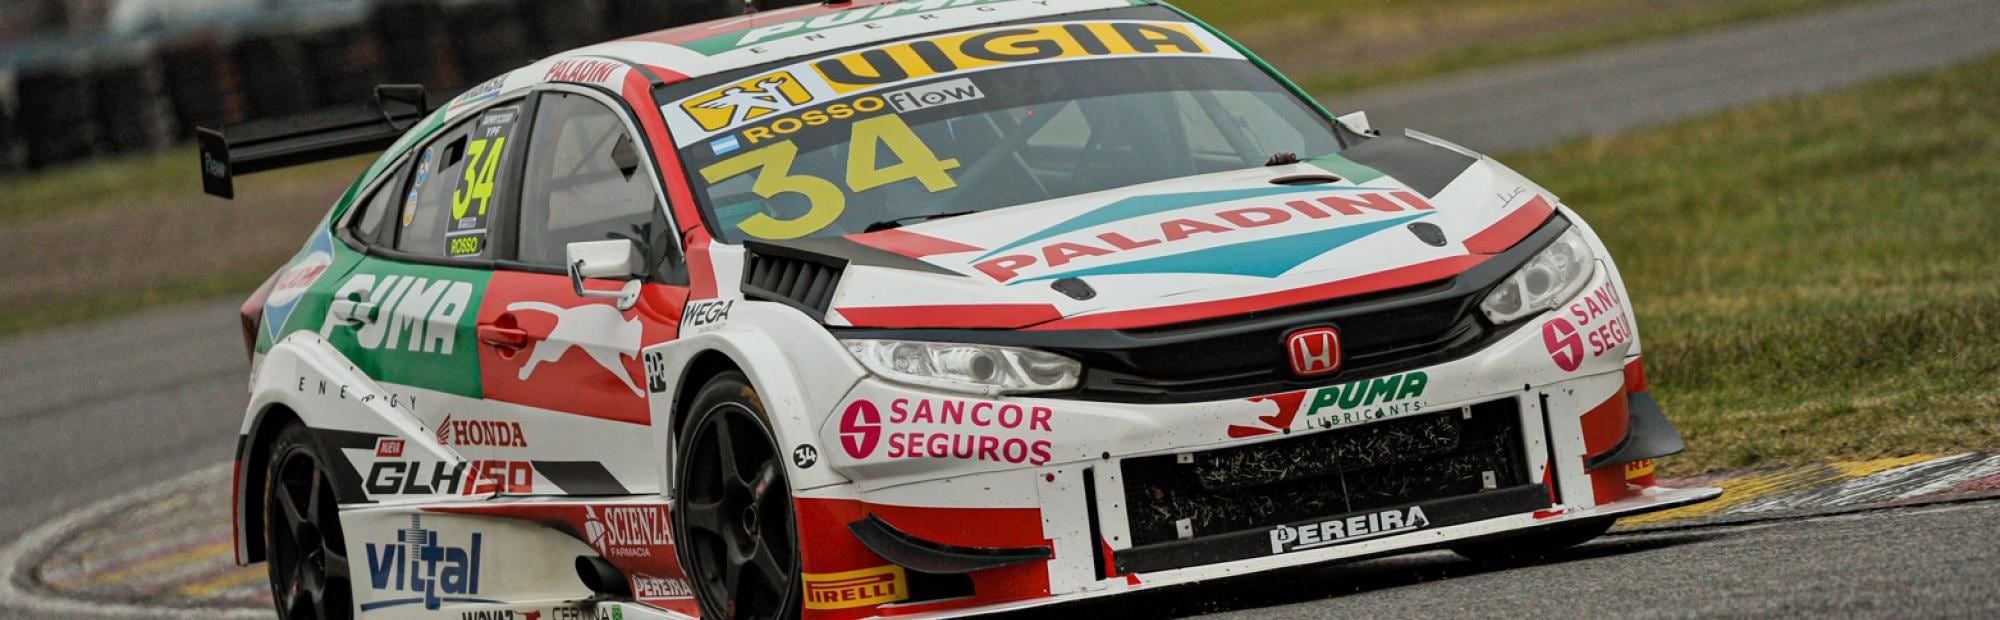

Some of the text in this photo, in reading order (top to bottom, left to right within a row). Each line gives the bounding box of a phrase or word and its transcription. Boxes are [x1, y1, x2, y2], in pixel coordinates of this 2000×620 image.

[750, 1, 1050, 56] ENERGY
[543, 60, 623, 82] PALADINI
[742, 84, 976, 144] ROSSO flow
[452, 137, 505, 220] 34
[700, 113, 961, 240] 34
[450, 237, 478, 254] ROSSO
[972, 190, 1437, 284] PALADINI
[318, 273, 474, 355] PUMA
[682, 299, 735, 326] WEGA
[1306, 371, 1429, 416] PUMA
[889, 398, 1053, 432] SANCOR
[1307, 401, 1421, 430] LUBRICANTS
[452, 420, 528, 448] HONDA
[887, 433, 1053, 466] SEGUROS
[794, 446, 818, 467] 34
[605, 506, 675, 546] SCIENZA
[1269, 505, 1430, 555] PEREIRA
[610, 547, 651, 557] FARMACIA
[632, 574, 693, 601] PEREIRA
[805, 571, 897, 603] PIRELLI
